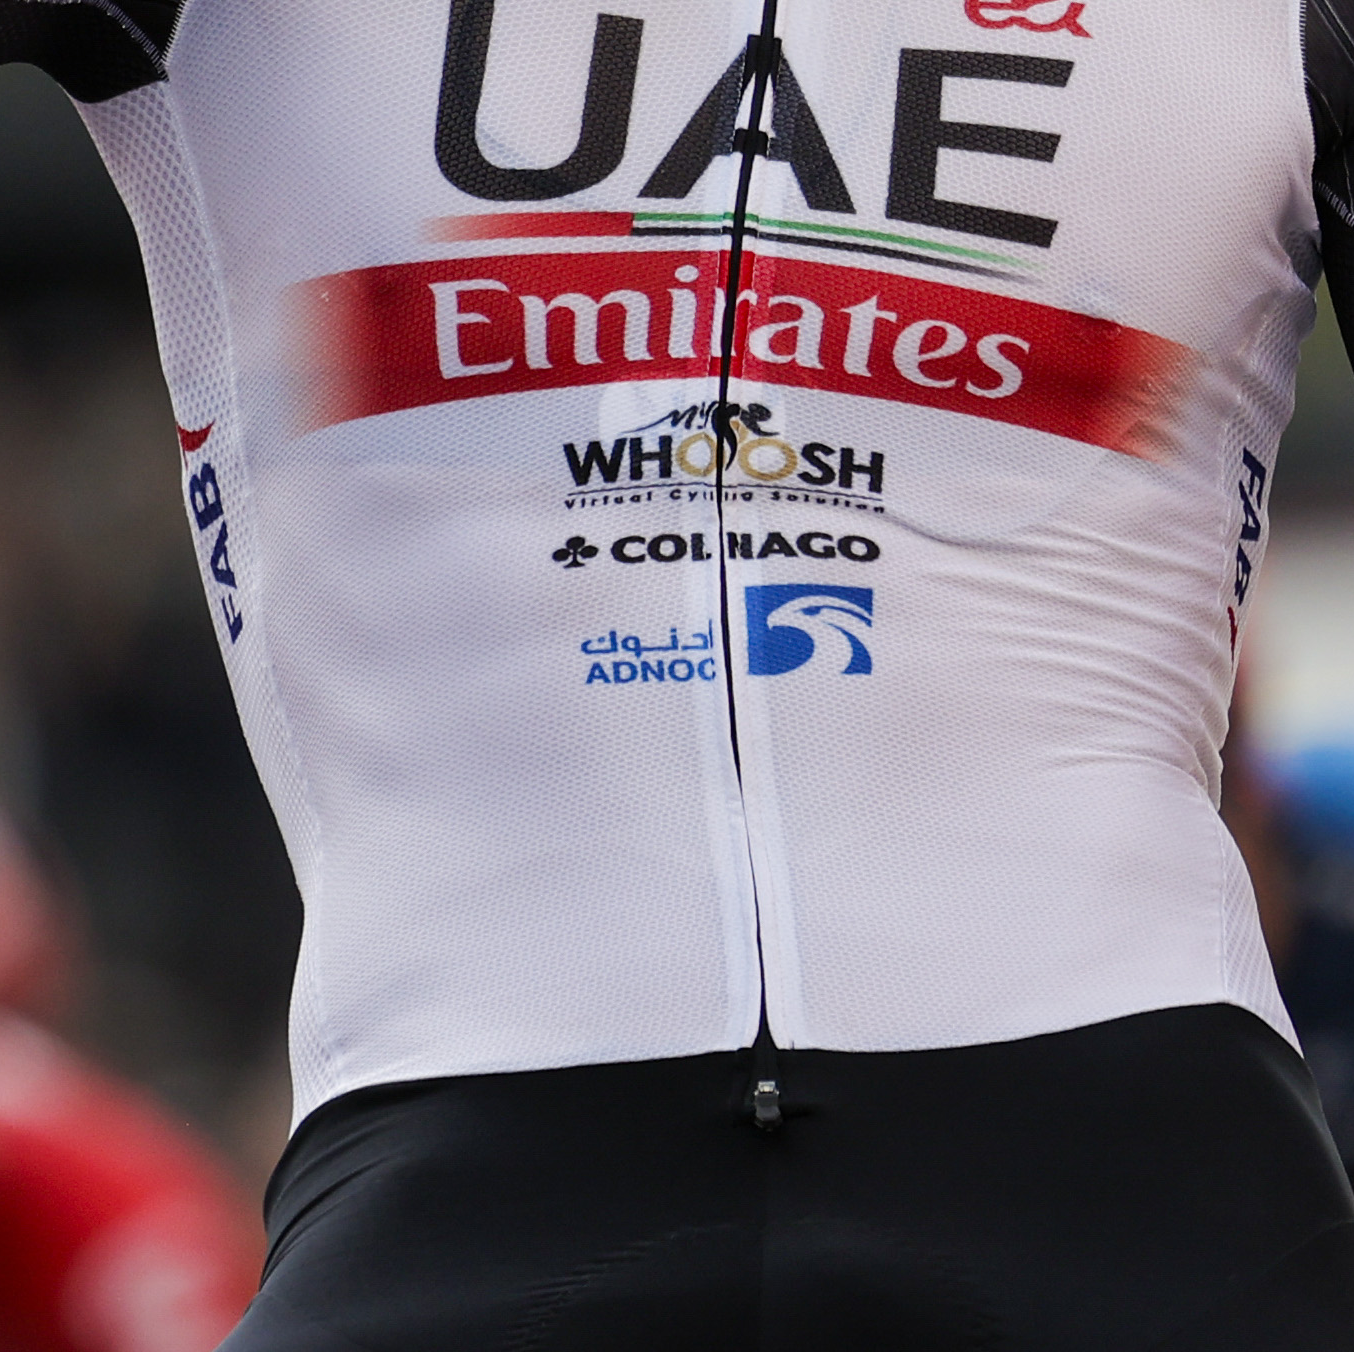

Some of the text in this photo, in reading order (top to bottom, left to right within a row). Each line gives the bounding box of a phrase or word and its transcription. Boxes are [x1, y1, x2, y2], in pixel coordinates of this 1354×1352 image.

[428, 264, 1032, 399] Emirates
[563, 433, 885, 494] WHOOSH
[189, 462, 243, 645] FAB
[610, 531, 881, 563] COLNAGO
[1234, 446, 1267, 607] FAB
[585, 657, 717, 684] ADNOC
